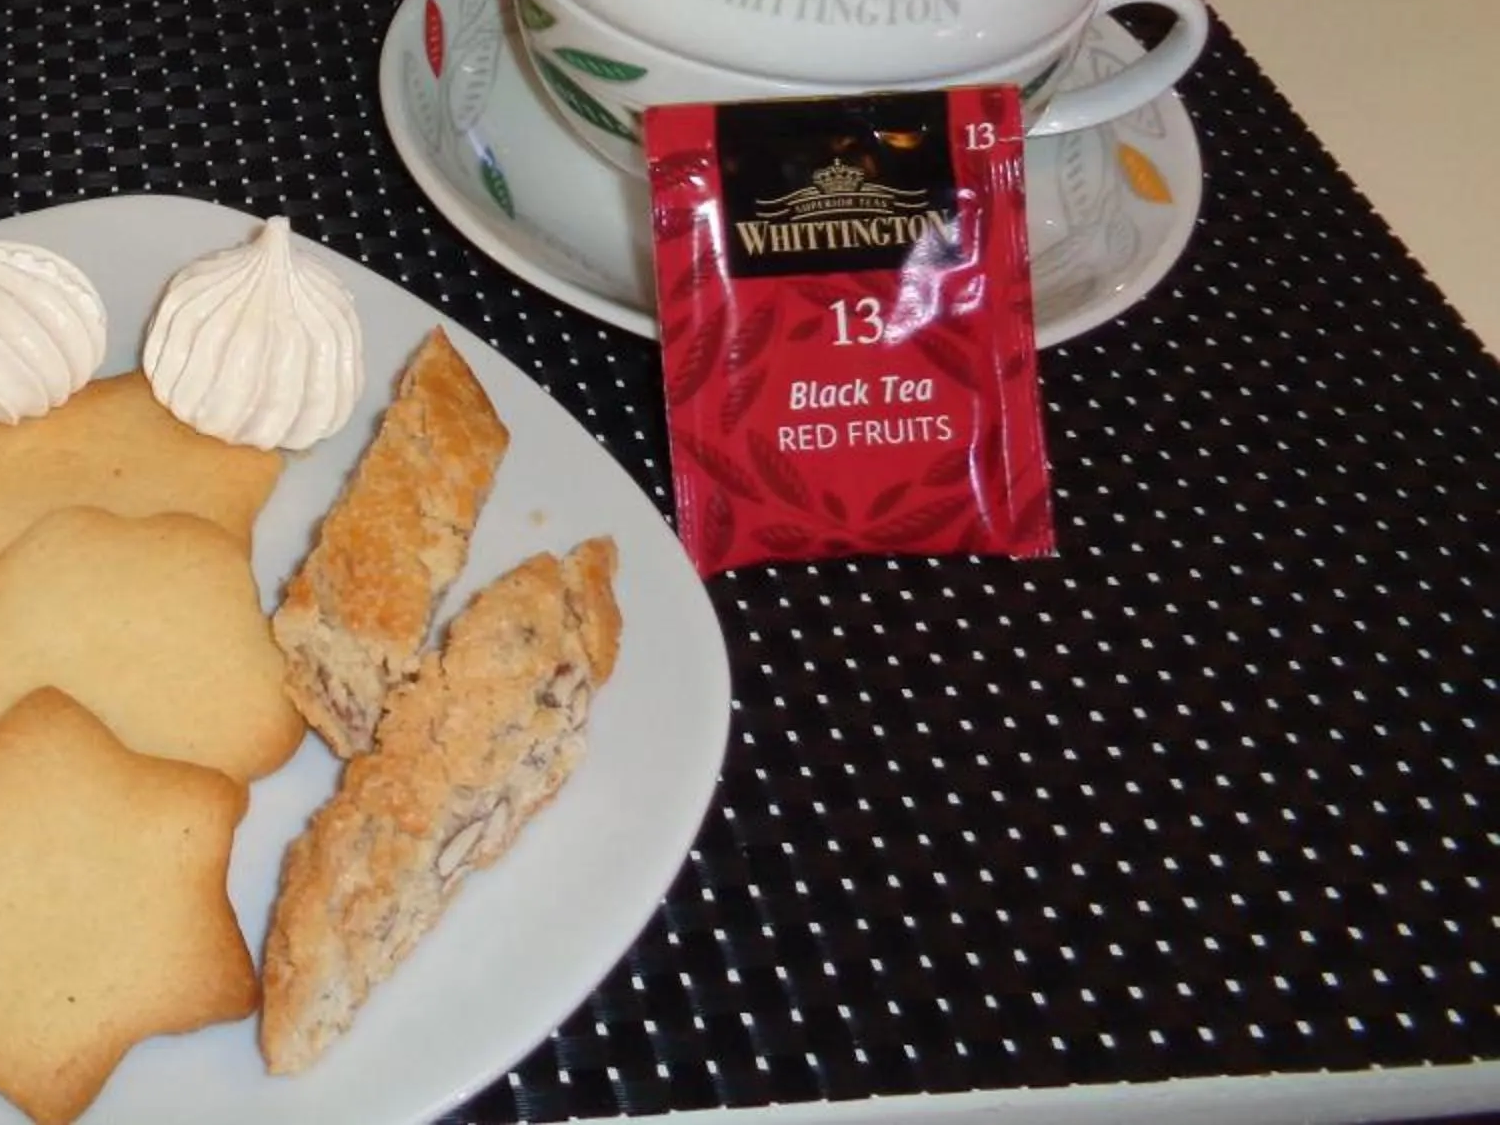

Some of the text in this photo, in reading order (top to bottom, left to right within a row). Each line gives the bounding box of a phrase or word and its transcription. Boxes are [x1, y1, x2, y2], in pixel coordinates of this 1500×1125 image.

[964, 122, 996, 150] 13
[735, 209, 950, 257] WHITTINGTON
[829, 297, 884, 347] 13
[789, 375, 934, 411] Black Tea
[777, 415, 953, 452] RED FRUITS
